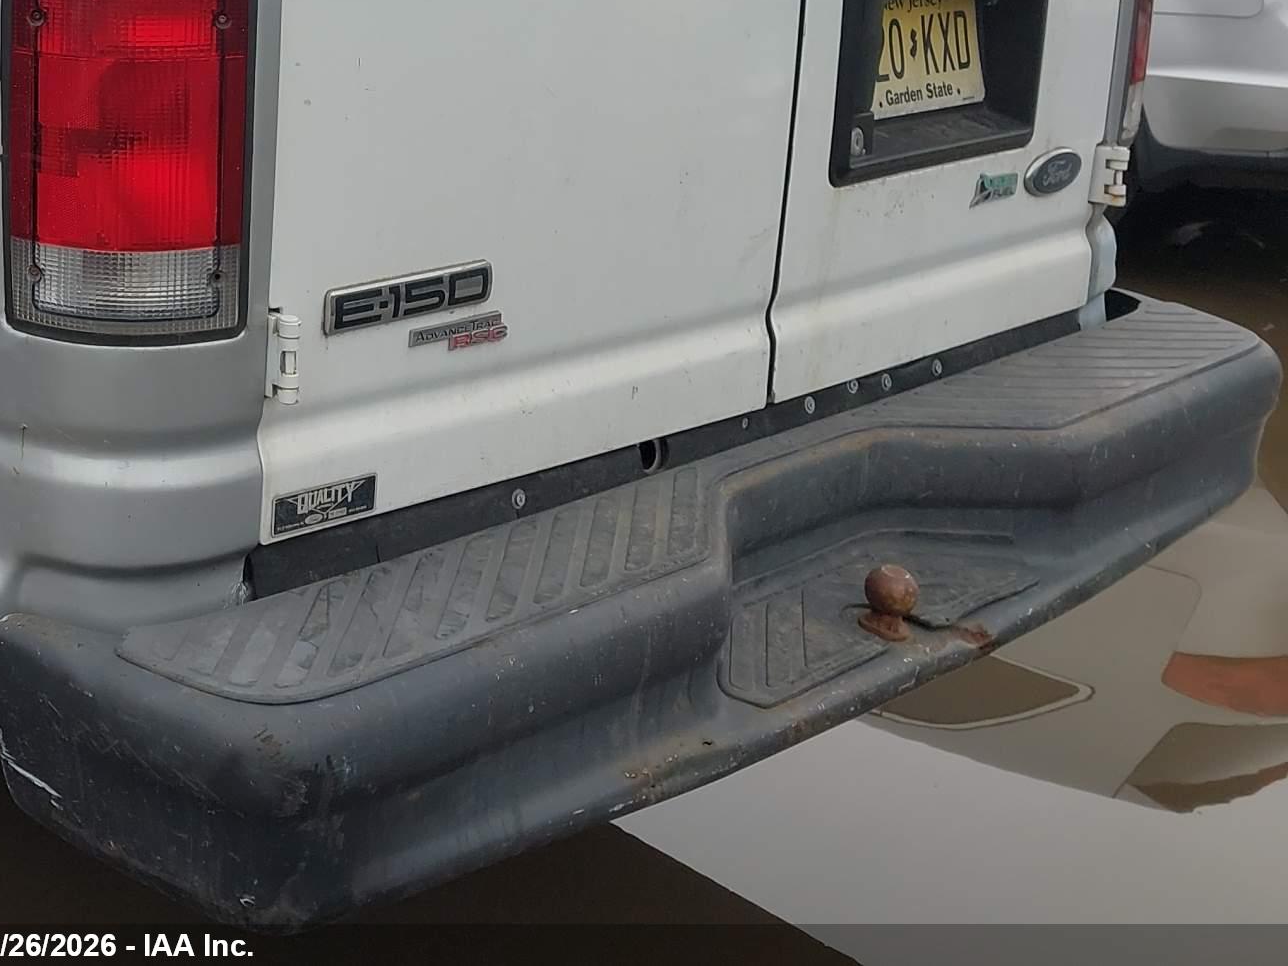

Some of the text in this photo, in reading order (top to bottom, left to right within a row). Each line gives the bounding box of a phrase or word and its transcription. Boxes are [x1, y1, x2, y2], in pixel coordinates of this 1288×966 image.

[920, 10, 971, 76] KXD
[885, 81, 954, 107] Garden State
[297, 481, 366, 515] QUALITY
